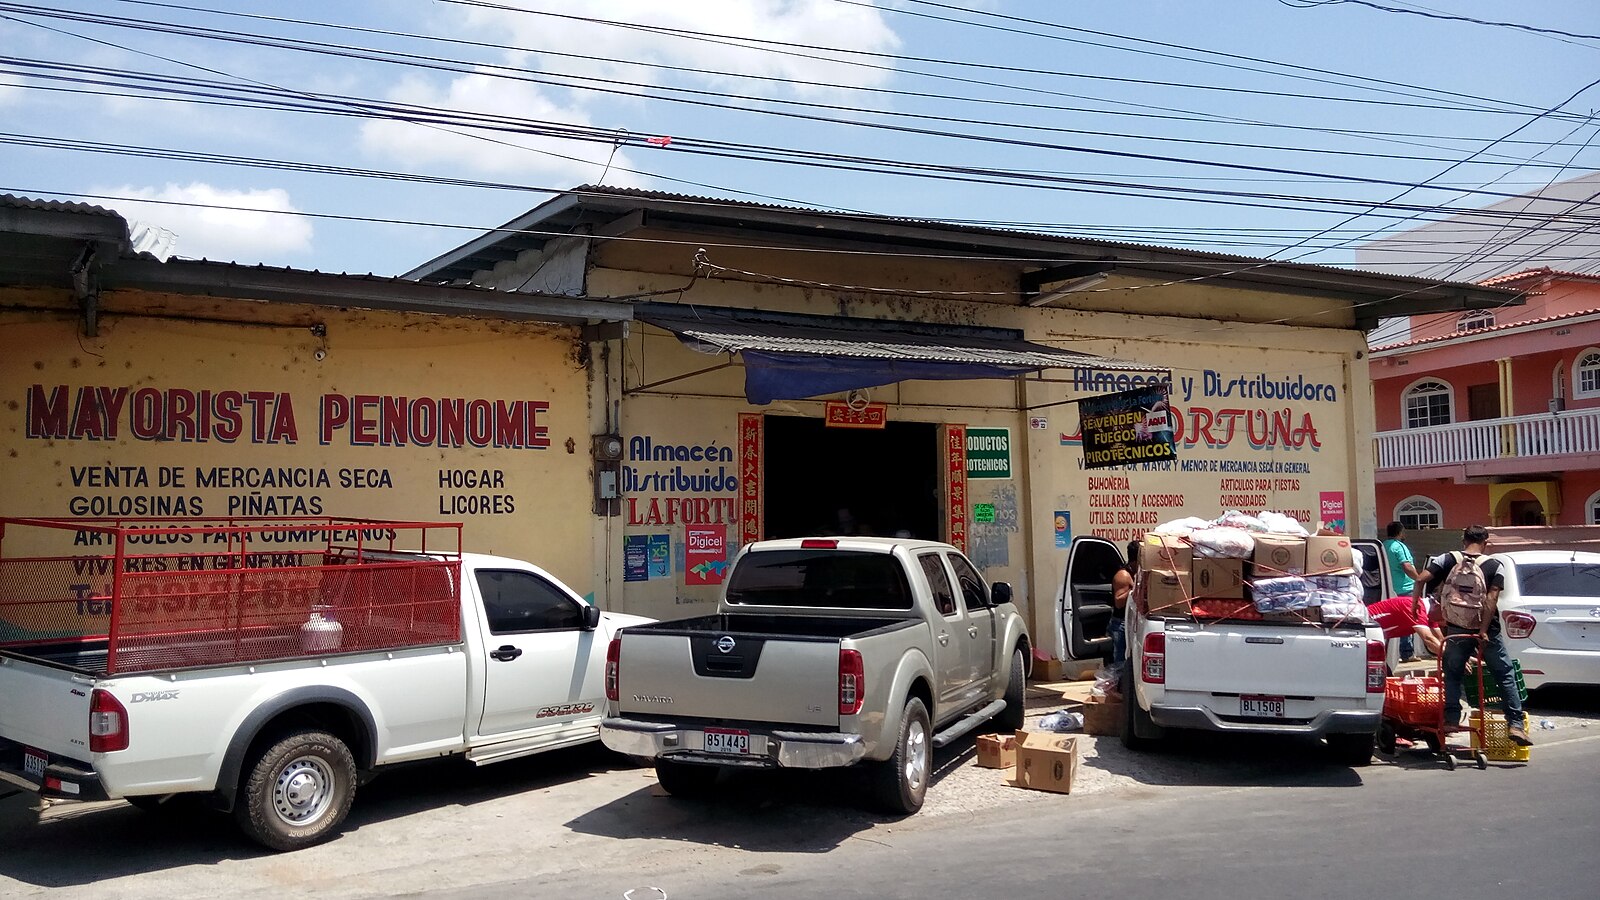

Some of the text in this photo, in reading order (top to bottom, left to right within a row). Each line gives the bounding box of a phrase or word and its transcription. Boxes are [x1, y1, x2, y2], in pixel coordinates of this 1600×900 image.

[1181, 376, 1194, 402] y
[1203, 369, 1337, 402] Distribuidora
[26, 383, 551, 449] MAYORISTA PENONOME
[1095, 412, 1143, 428] VENDEN
[1147, 416, 1167, 427] AQUI
[1094, 428, 1137, 445] FUEGOS
[1169, 406, 1322, 452] ORTUNA
[630, 435, 733, 462] Almacén
[966, 436, 1008, 451] ODUCTOS
[1086, 442, 1171, 464] PIROTECNICOS
[1143, 459, 1171, 471] MAYOR
[1172, 460, 1180, 471] Y
[1181, 460, 1208, 472] MENOR
[1209, 461, 1218, 471] DE
[1219, 460, 1257, 473] MERCANCIA
[1258, 462, 1274, 473] SECA
[1275, 462, 1283, 473] EN
[1284, 462, 1310, 474] GENERAL
[70, 466, 393, 489] VENTA DE MERCANCIA SECA
[438, 469, 505, 489] HOGAR
[1220, 479, 1300, 491] ARTICULOS PARA FIESTAS
[69, 491, 324, 516] GOLOSINAS PIÑATAS
[439, 495, 516, 515] LICORES
[1089, 494, 1185, 508] CELULARES Y ACCESORIOS
[1219, 494, 1267, 507] CURIOSIDADES
[1322, 500, 1344, 510] Digicel
[1089, 511, 1159, 524] UTILES ESCOLARES
[74, 525, 194, 546] ARTCULOS
[689, 536, 722, 549] Digicel
[71, 555, 168, 576] VIVRES
[707, 733, 746, 749] 851443
